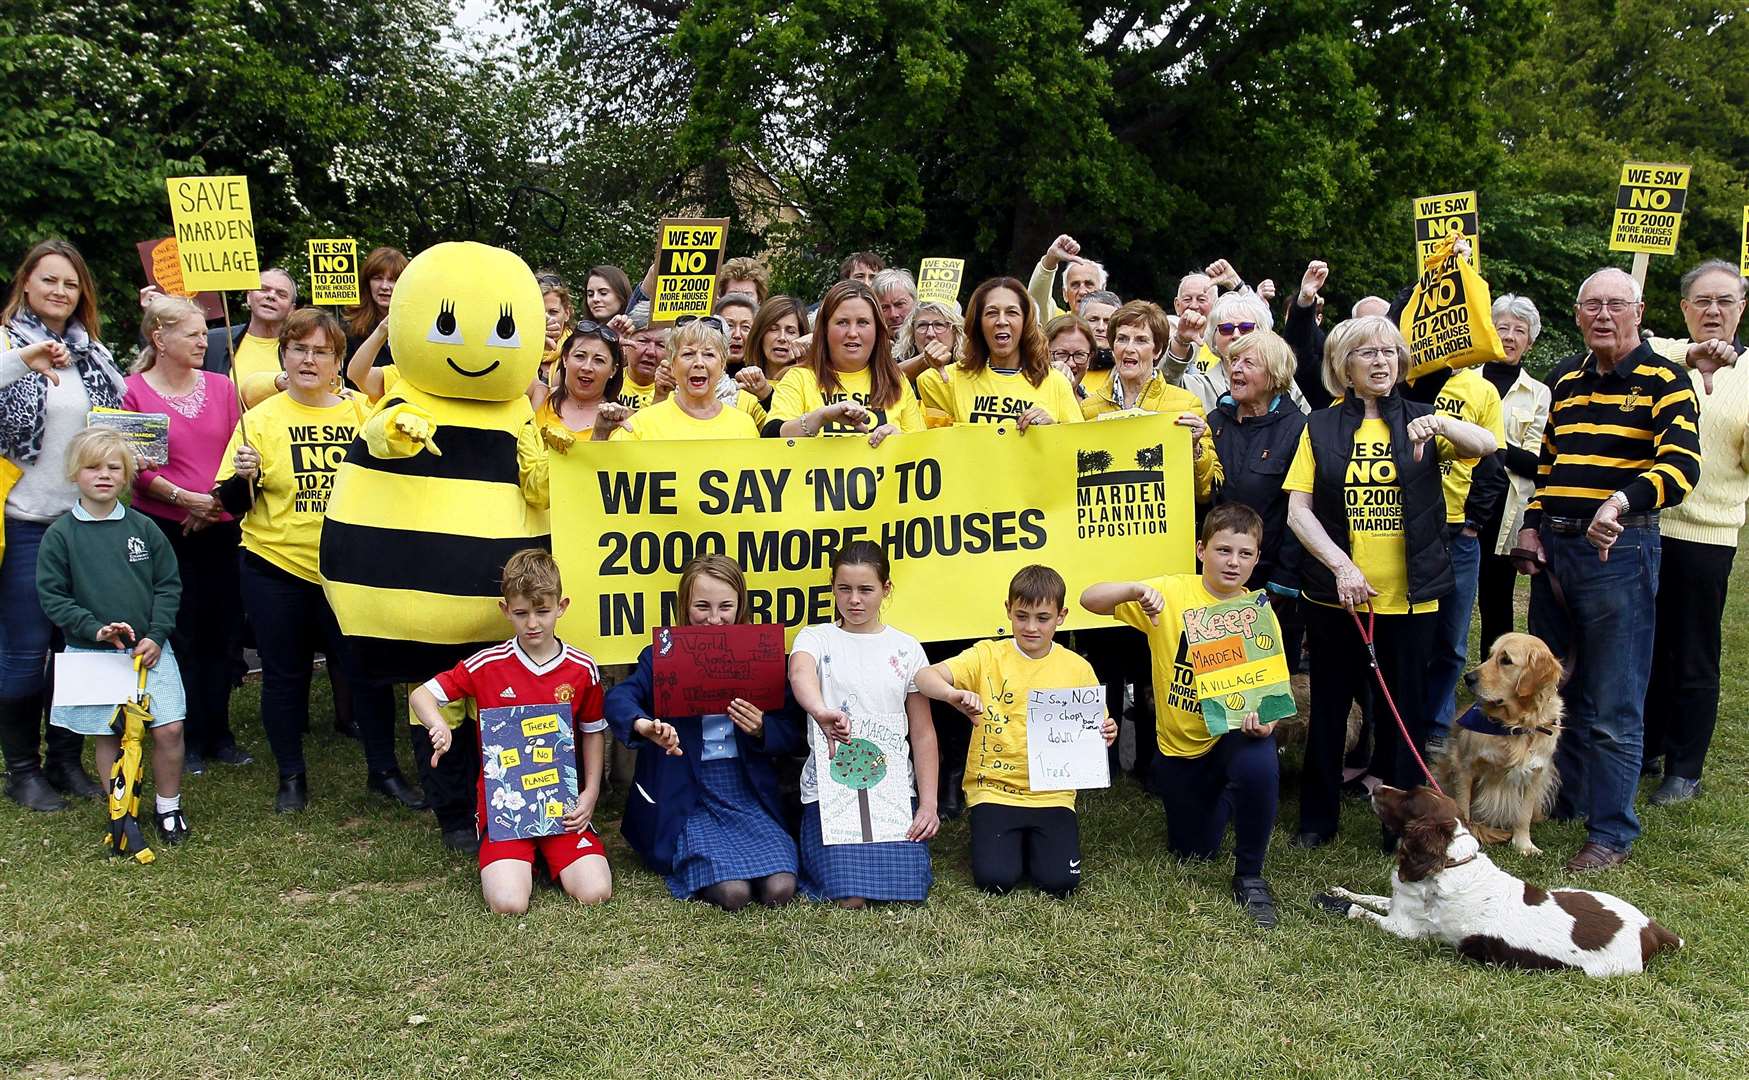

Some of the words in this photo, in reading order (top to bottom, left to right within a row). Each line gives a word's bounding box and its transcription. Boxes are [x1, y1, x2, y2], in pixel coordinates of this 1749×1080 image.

[1628, 169, 1651, 184] WE
[1654, 171, 1683, 186] SAY
[178, 182, 243, 213] SAVE
[1629, 188, 1671, 210] NO
[1421, 201, 1441, 216] WE
[1445, 198, 1469, 213] SAY
[1428, 216, 1464, 238] NO
[1620, 212, 1637, 225] TO
[1640, 214, 1675, 228] 2000
[179, 219, 254, 243] MARDEN
[668, 231, 690, 246] WE
[692, 231, 717, 246] SAY
[1617, 224, 1640, 233] MORE
[1641, 226, 1672, 236] HOUSES
[312, 242, 330, 253] WE
[332, 242, 352, 253] SAY
[1615, 233, 1625, 242] IN
[1628, 235, 1671, 246] MARDEN
[183, 250, 256, 273] VILLAGE
[318, 255, 349, 272] NO
[670, 251, 707, 273] NO
[942, 260, 961, 269] SAY
[314, 275, 327, 284] TO
[329, 275, 356, 284] 2000
[926, 269, 955, 281] NO
[662, 279, 677, 292] TO
[680, 279, 710, 291] 2000
[934, 281, 958, 291] 2000
[660, 293, 680, 301] MORE
[681, 292, 708, 300] HOUSES
[1418, 278, 1456, 317] NO
[658, 302, 668, 312] IN
[669, 301, 708, 311] MARDEN
[1412, 321, 1427, 341] TO
[1430, 306, 1469, 334] 2000
[1410, 335, 1433, 353] MORE
[1436, 323, 1470, 344] HOUSES
[1423, 334, 1473, 362] MARDEN
[1196, 361, 1209, 372] AY
[619, 394, 640, 409] WE
[974, 396, 998, 412] WE
[1001, 397, 1034, 414] SAY
[1436, 397, 1466, 414] SAY
[288, 426, 318, 442] WE
[322, 426, 355, 442] SAY
[300, 445, 347, 471] NO
[1355, 443, 1367, 457] E
[1345, 460, 1397, 484] NO
[294, 475, 317, 490] TO
[597, 471, 678, 515] WE
[698, 468, 792, 516] SAY
[895, 458, 942, 504] TO
[296, 491, 322, 500] MORE
[1077, 482, 1166, 507] MARDEN
[295, 501, 307, 513] IN
[1078, 502, 1166, 524] PLANNING
[1347, 507, 1365, 517] ORE
[1078, 520, 1168, 539] OPPOSITION
[598, 531, 726, 576] 2000
[881, 508, 1048, 560] HOUSES
[599, 592, 645, 636] IN
[1174, 665, 1194, 686] TO
[1200, 681, 1209, 695] A
[1211, 669, 1268, 692] VILLAGE
[986, 676, 1014, 705] We
[1030, 690, 1044, 705] I
[1071, 688, 1101, 706] NO!
[1170, 682, 1197, 700] MORE
[1168, 693, 1180, 708] IN
[522, 719, 555, 732] THERE
[984, 724, 1002, 735] no
[1047, 726, 1074, 744] down
[981, 735, 1003, 753] to
[503, 755, 516, 764] IS
[523, 773, 557, 786] PLANET
